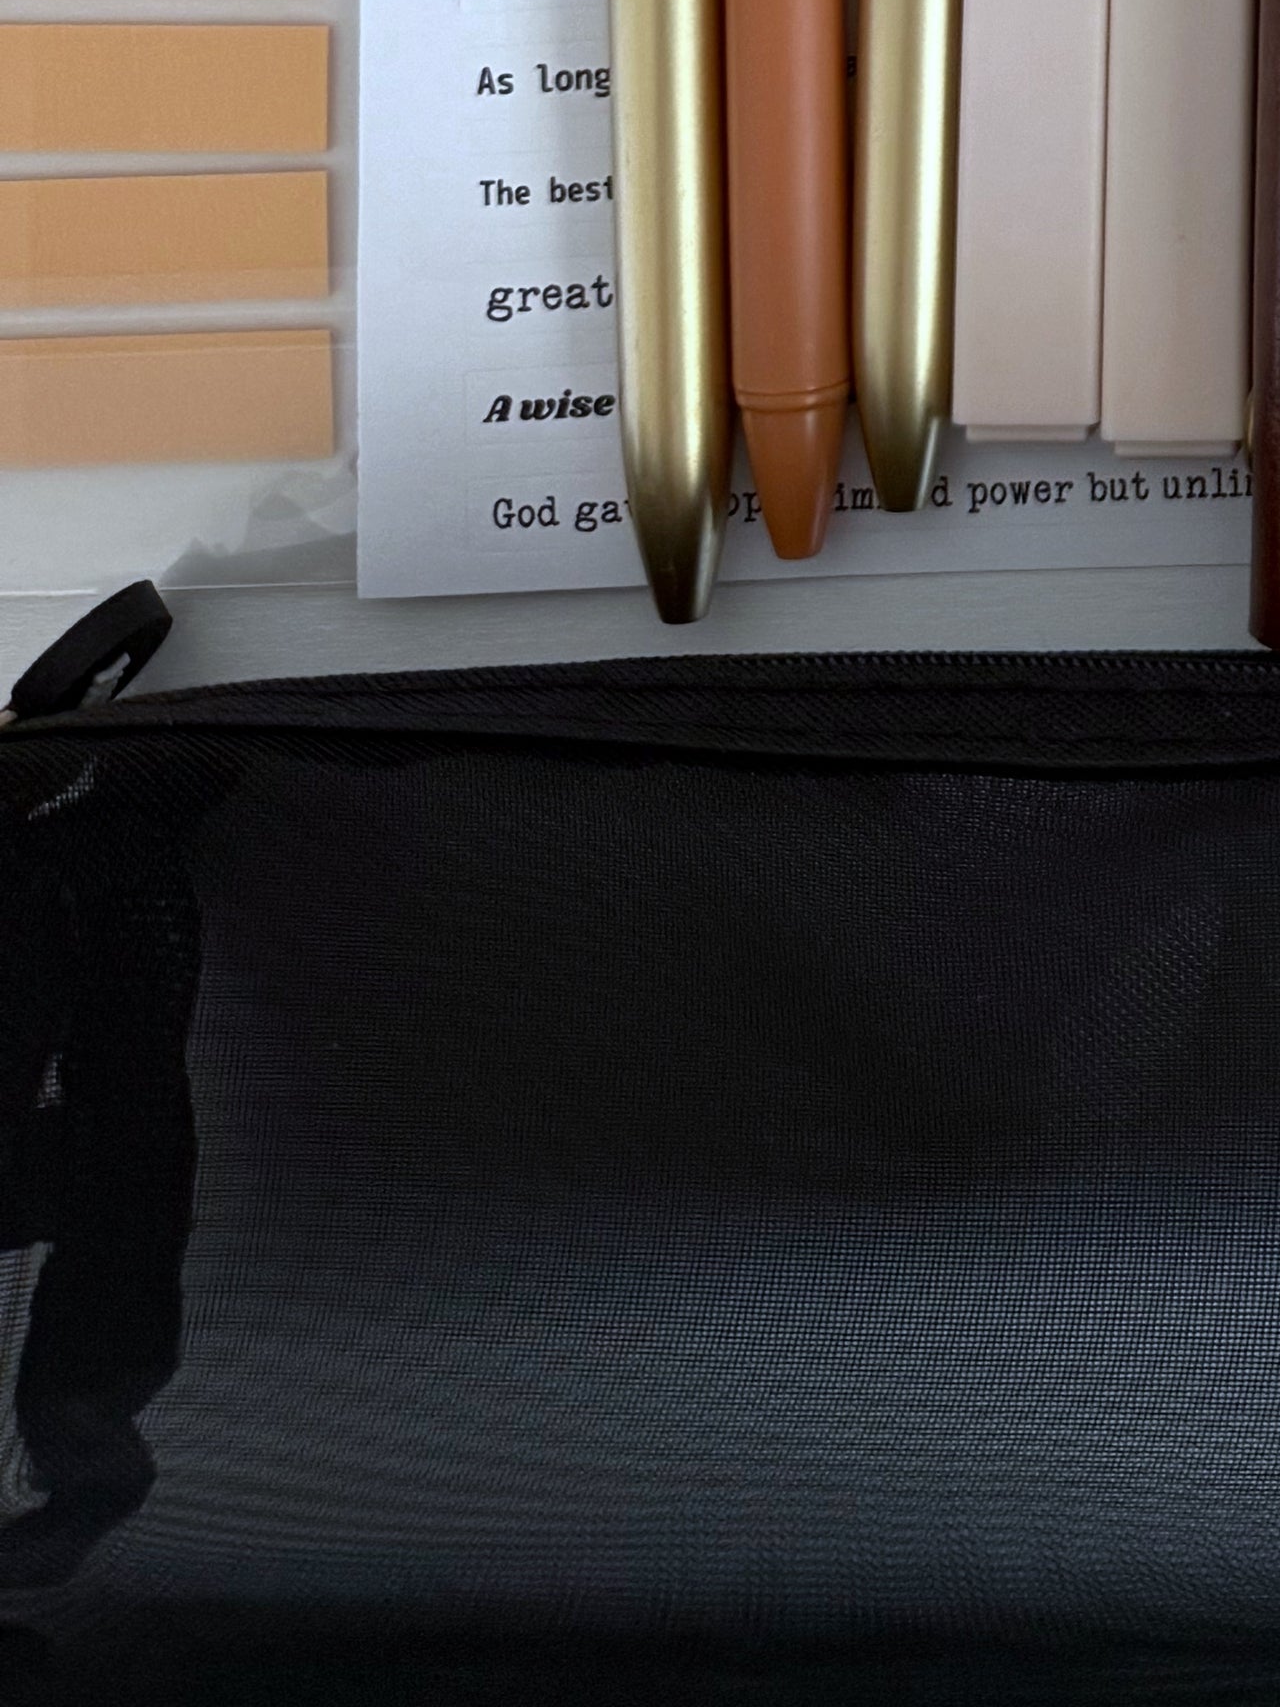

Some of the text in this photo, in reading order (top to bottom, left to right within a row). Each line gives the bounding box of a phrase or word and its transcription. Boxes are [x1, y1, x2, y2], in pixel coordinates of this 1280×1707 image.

[476, 67, 514, 97] As
[480, 179, 531, 206] The
[486, 275, 614, 322] great
[482, 388, 616, 423] A wise
[967, 477, 1073, 514] power
[1087, 472, 1149, 502] but
[492, 496, 559, 530] God
